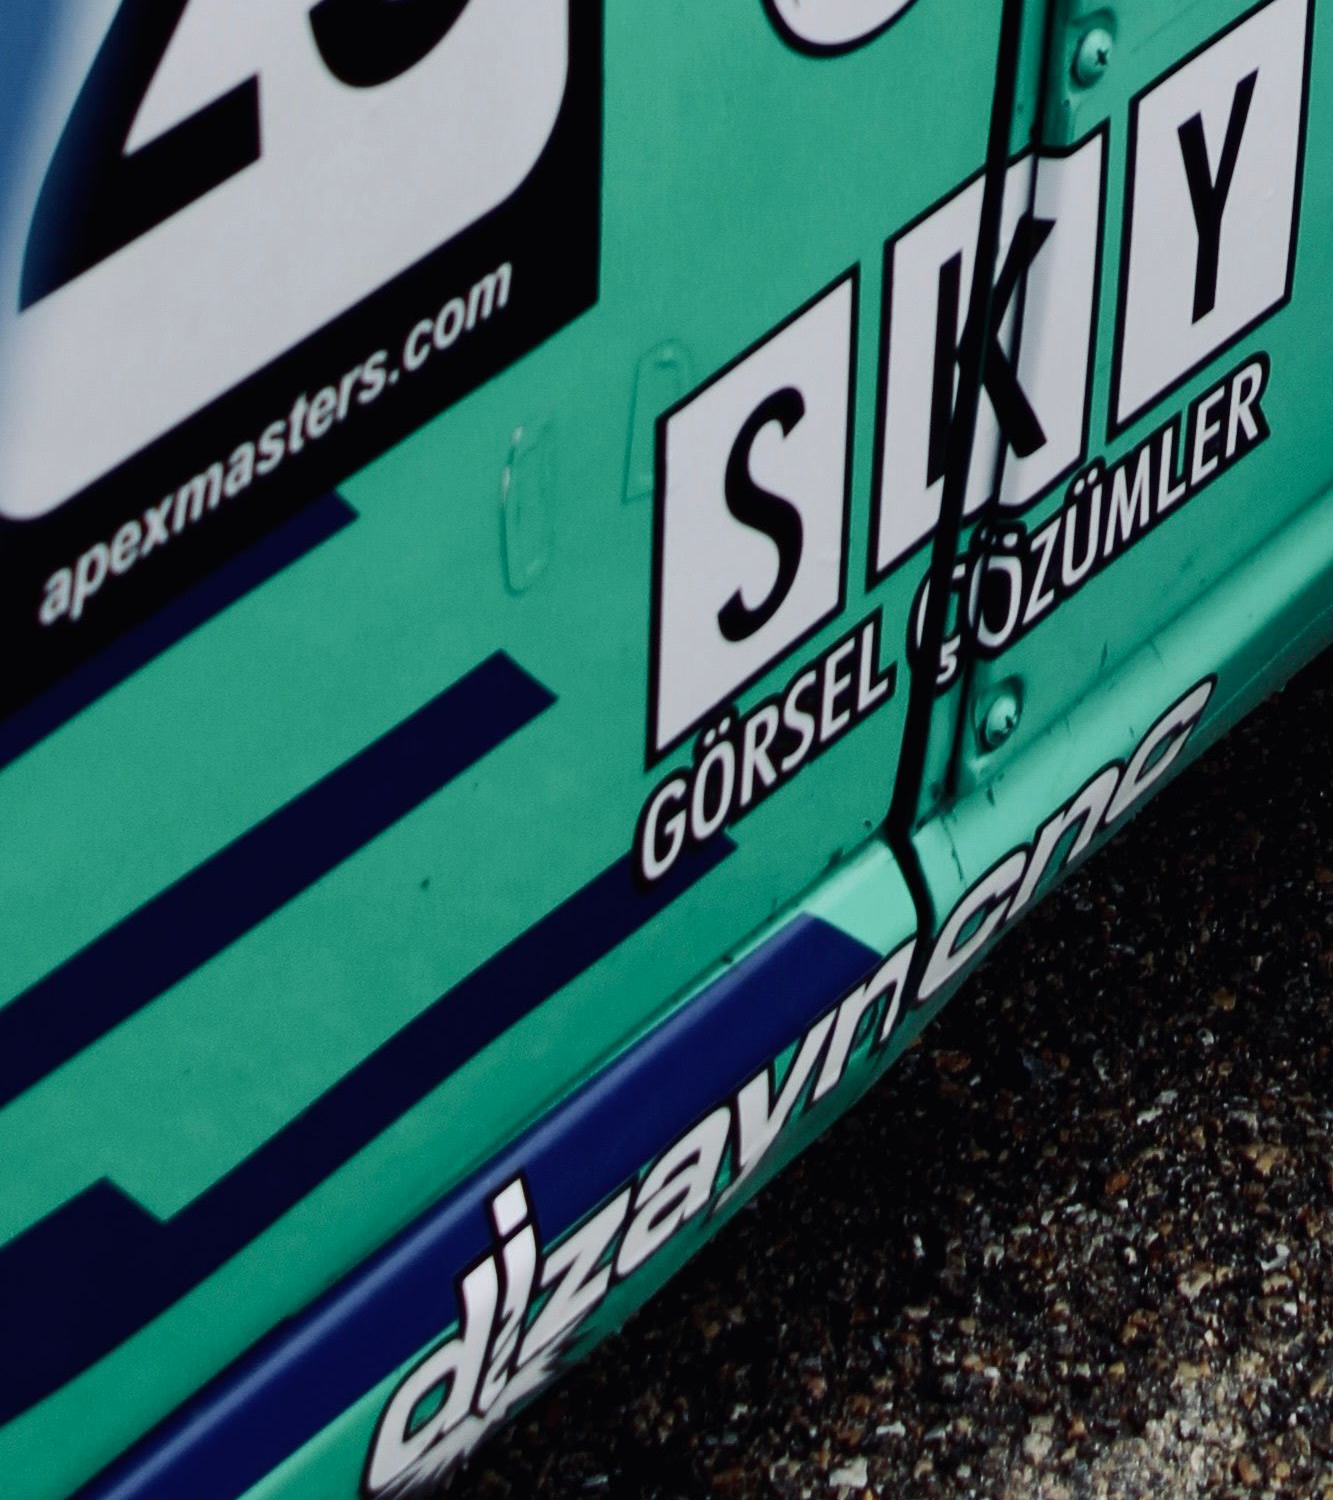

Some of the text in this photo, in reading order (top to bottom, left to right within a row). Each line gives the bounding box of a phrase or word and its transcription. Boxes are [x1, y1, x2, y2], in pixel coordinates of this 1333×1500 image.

[38, 260, 514, 626] apexmasters.com
[716, 67, 1260, 643] SKY
[639, 616, 894, 883] GÖRSEL
